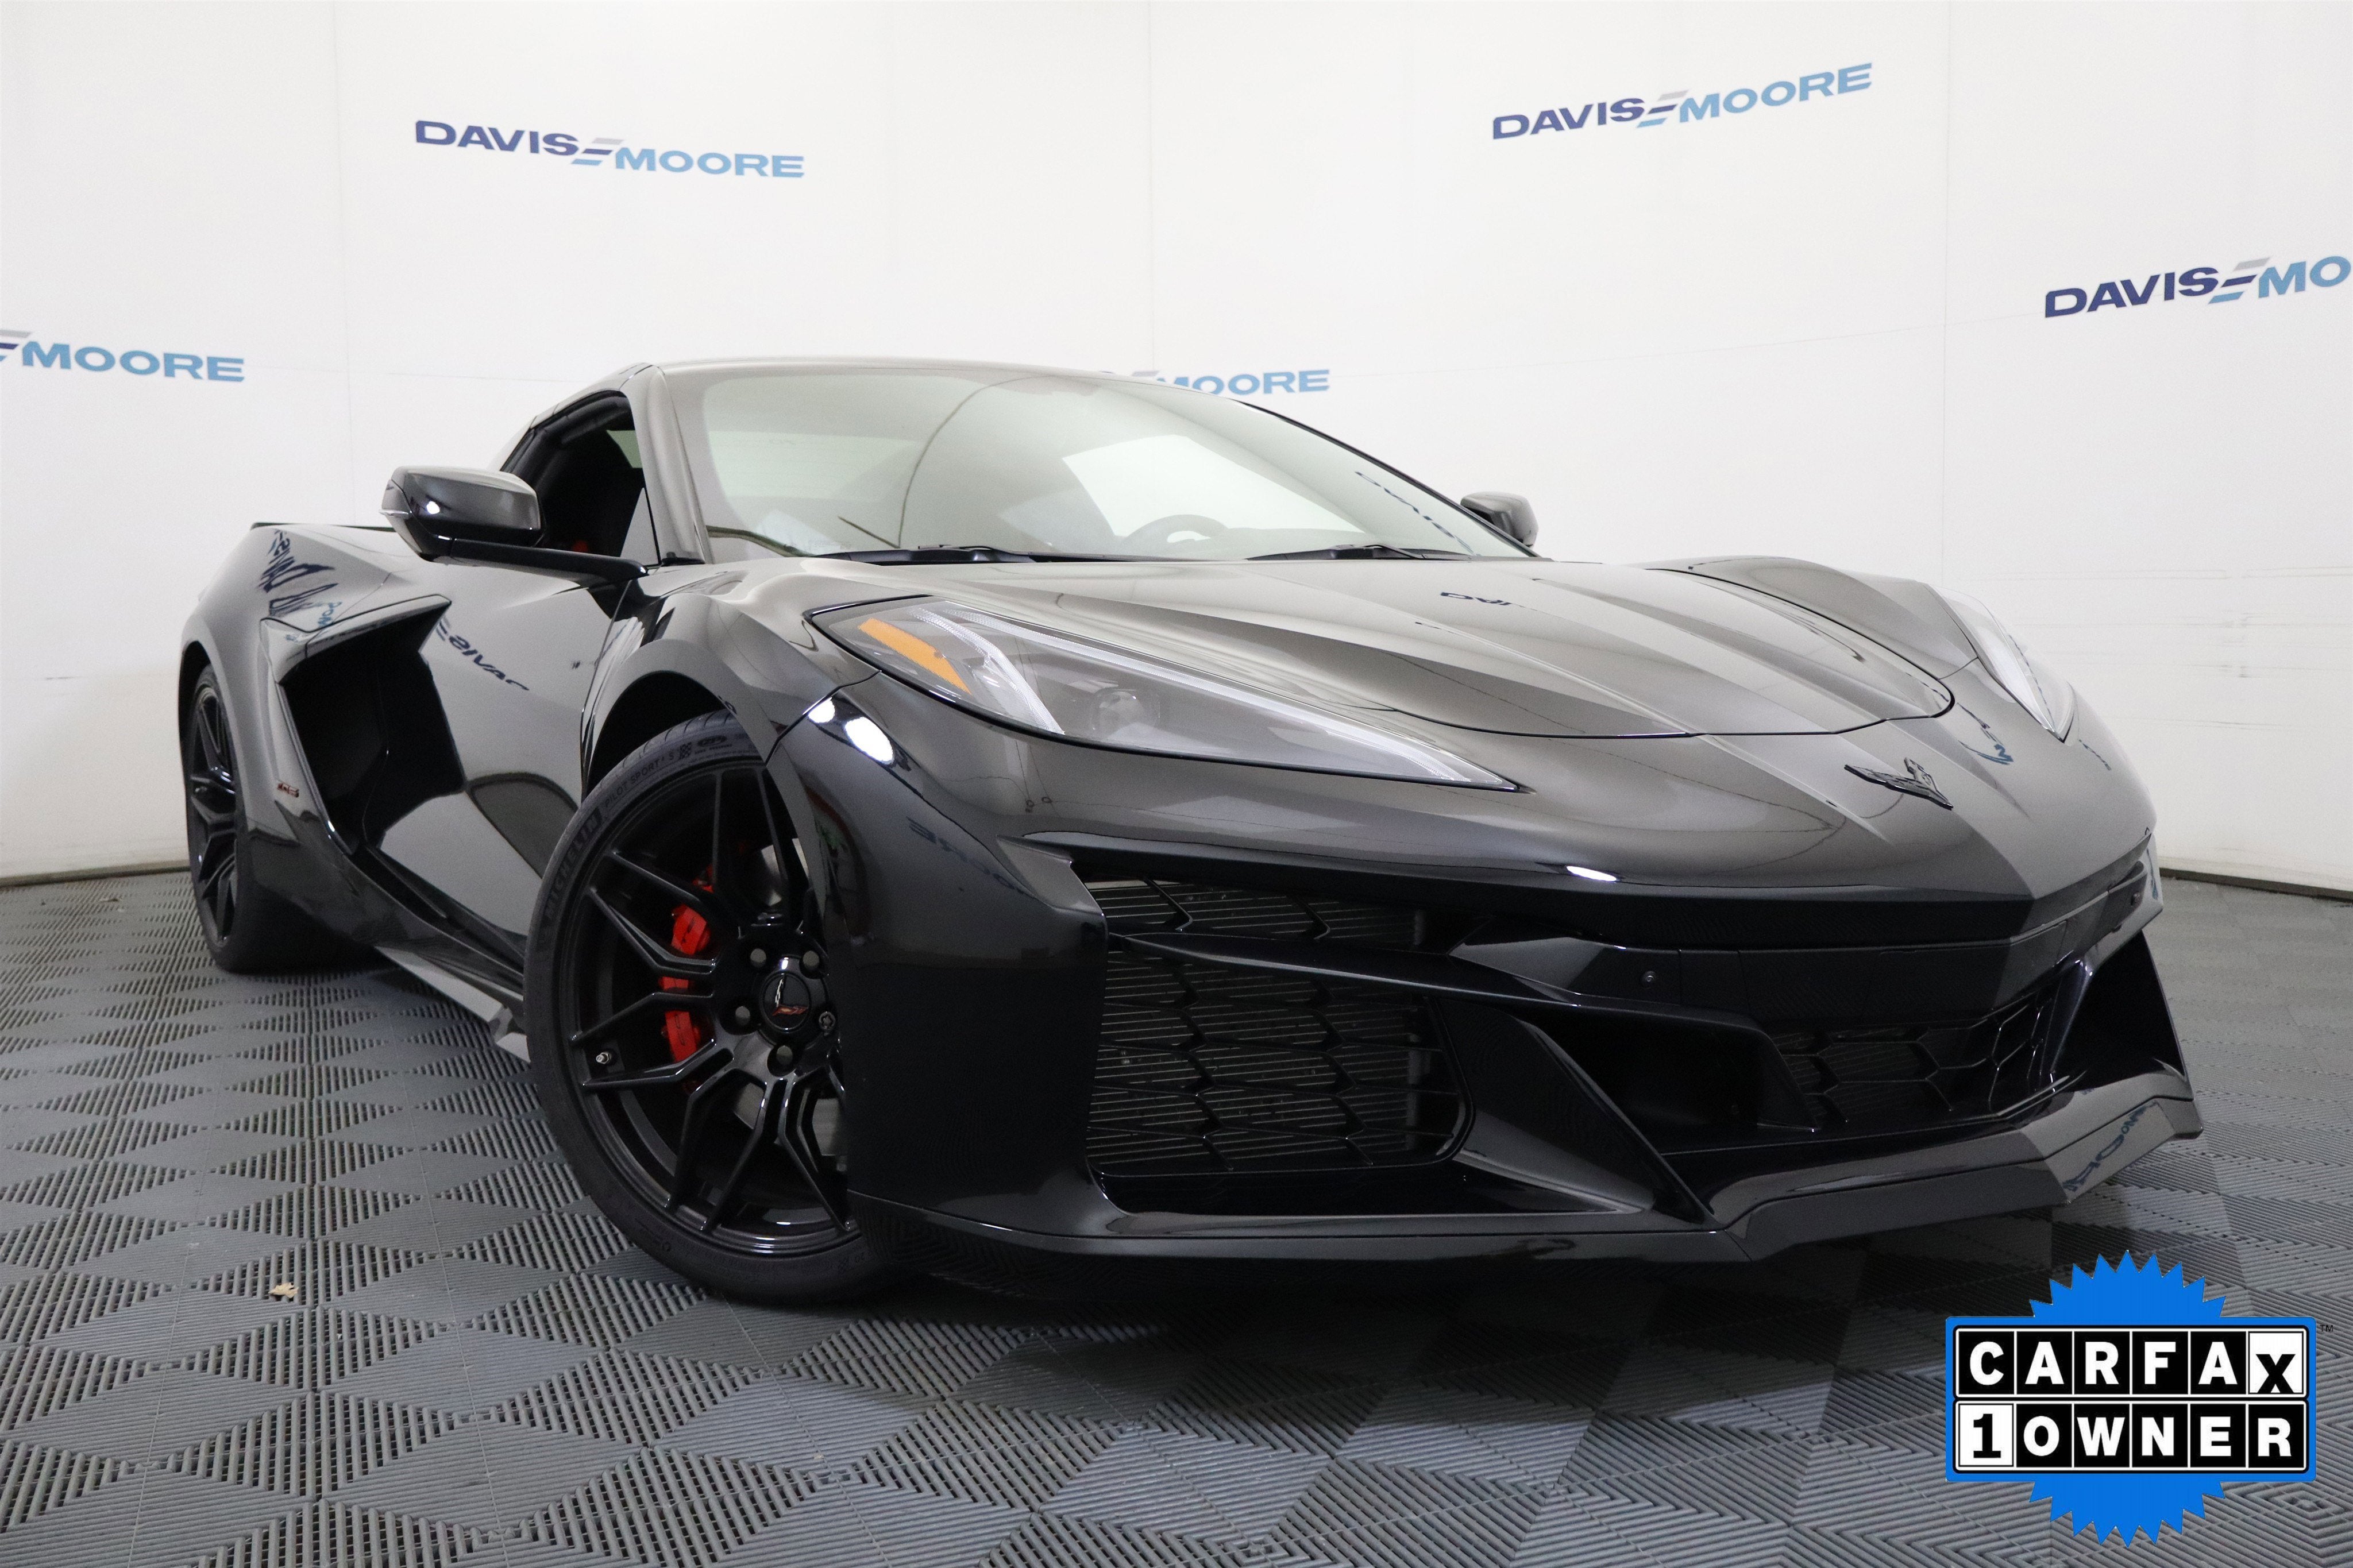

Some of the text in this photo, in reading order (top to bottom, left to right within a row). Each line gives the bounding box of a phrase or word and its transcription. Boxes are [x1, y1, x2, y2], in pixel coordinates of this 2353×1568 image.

[1492, 62, 1872, 140] DAVIS MOORE
[415, 120, 804, 178] DAVIS MOORE
[2045, 267, 2219, 318] DAVIS
[22, 341, 245, 382] MOORE
[1156, 369, 1330, 396] OORE
